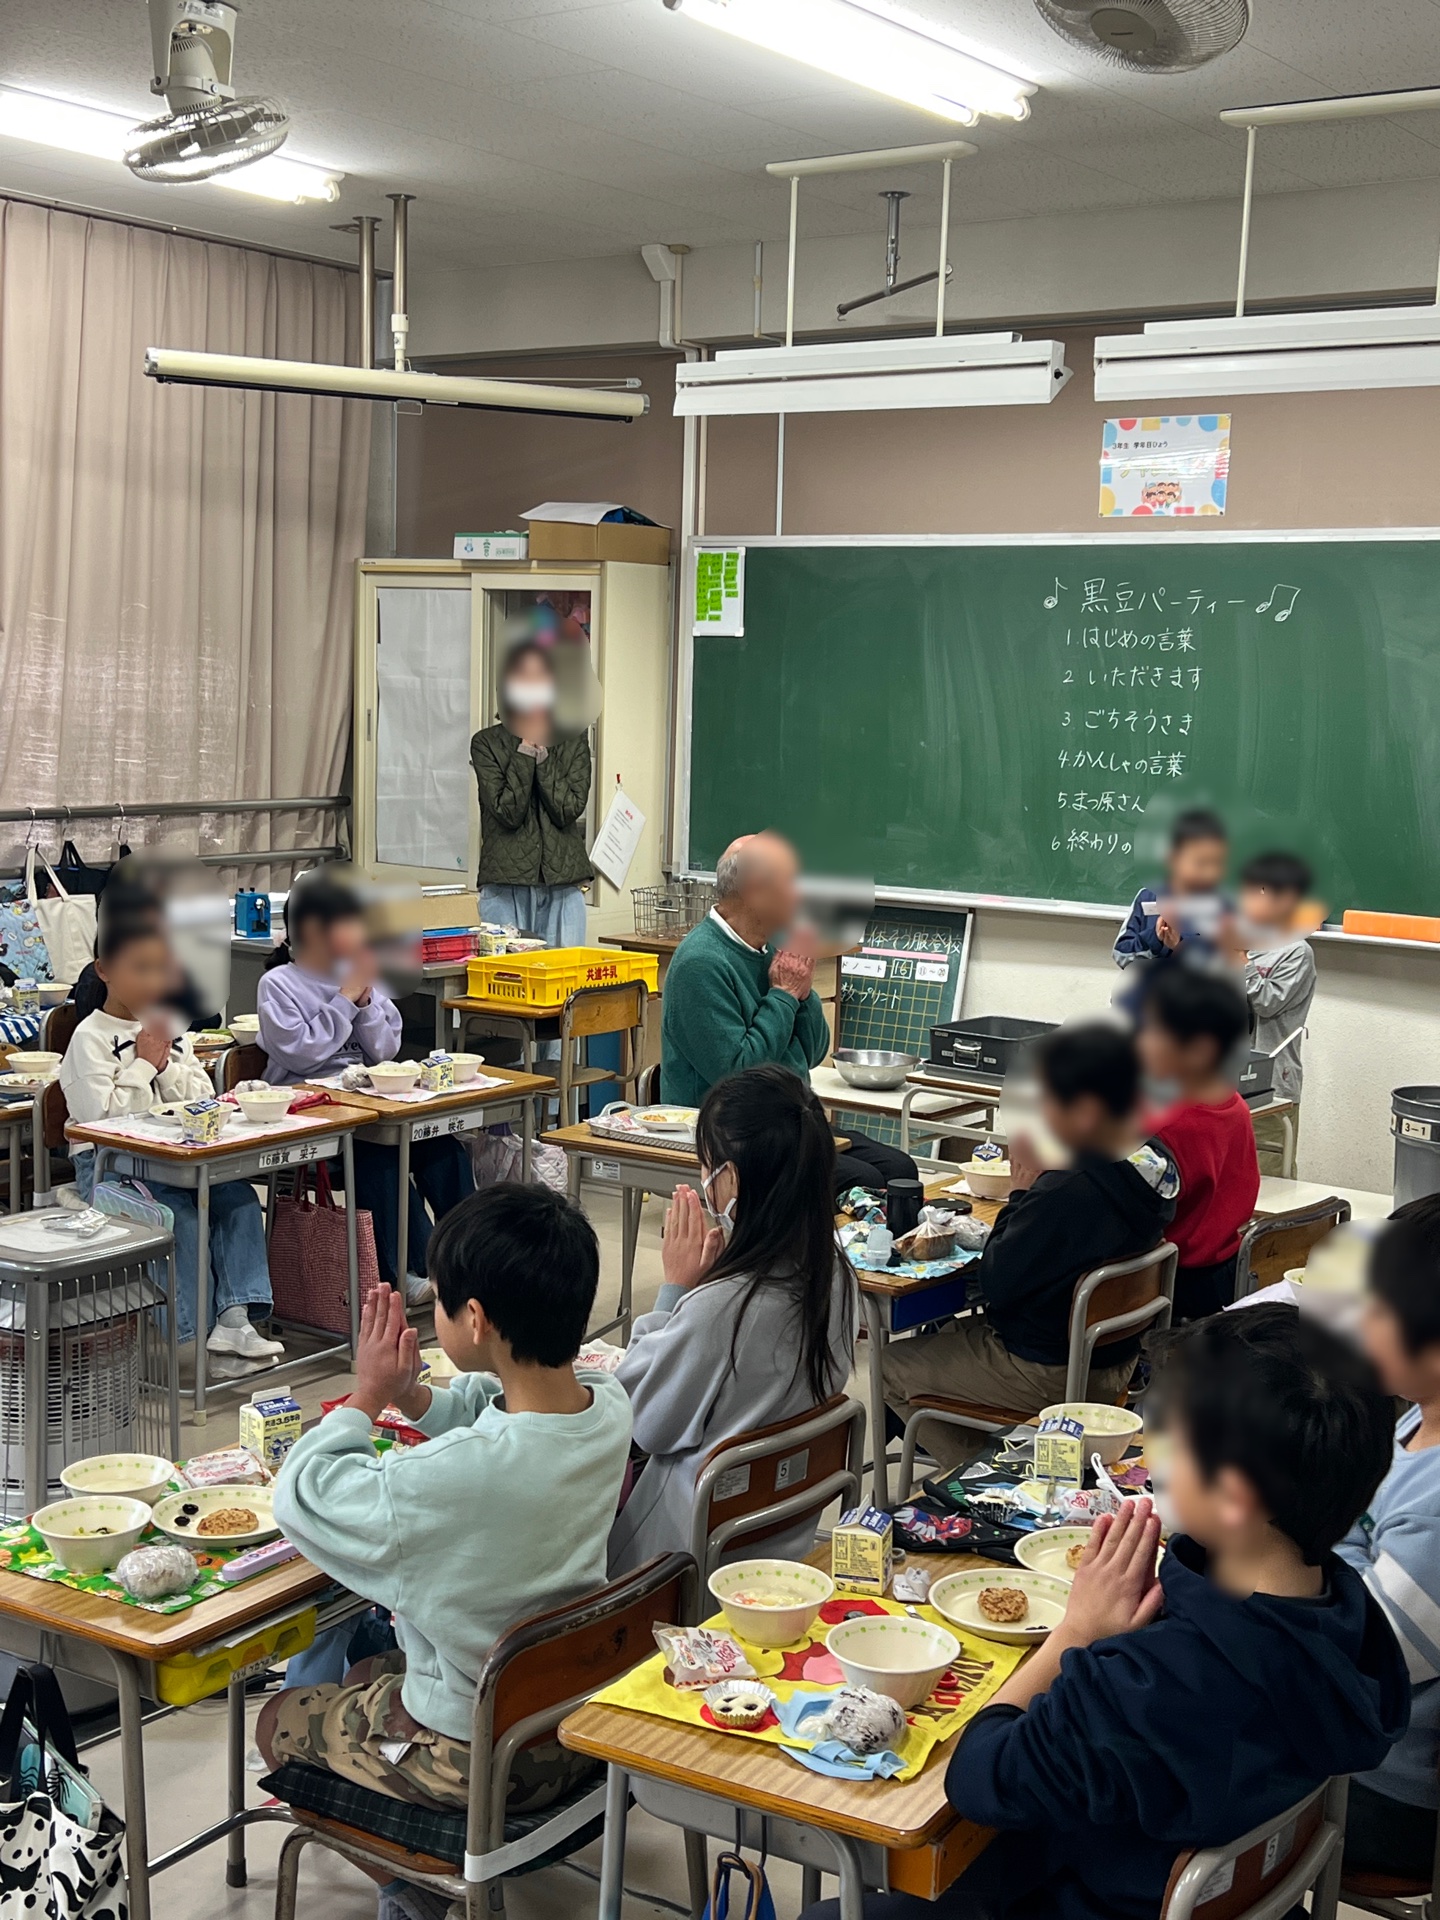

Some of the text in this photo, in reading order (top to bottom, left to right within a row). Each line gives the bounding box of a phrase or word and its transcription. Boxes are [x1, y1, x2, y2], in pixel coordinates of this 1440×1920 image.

[1081, 578, 1246, 614] 黒豆パーティー
[594, 1160, 601, 1170] 5
[780, 1462, 787, 1477] 5
